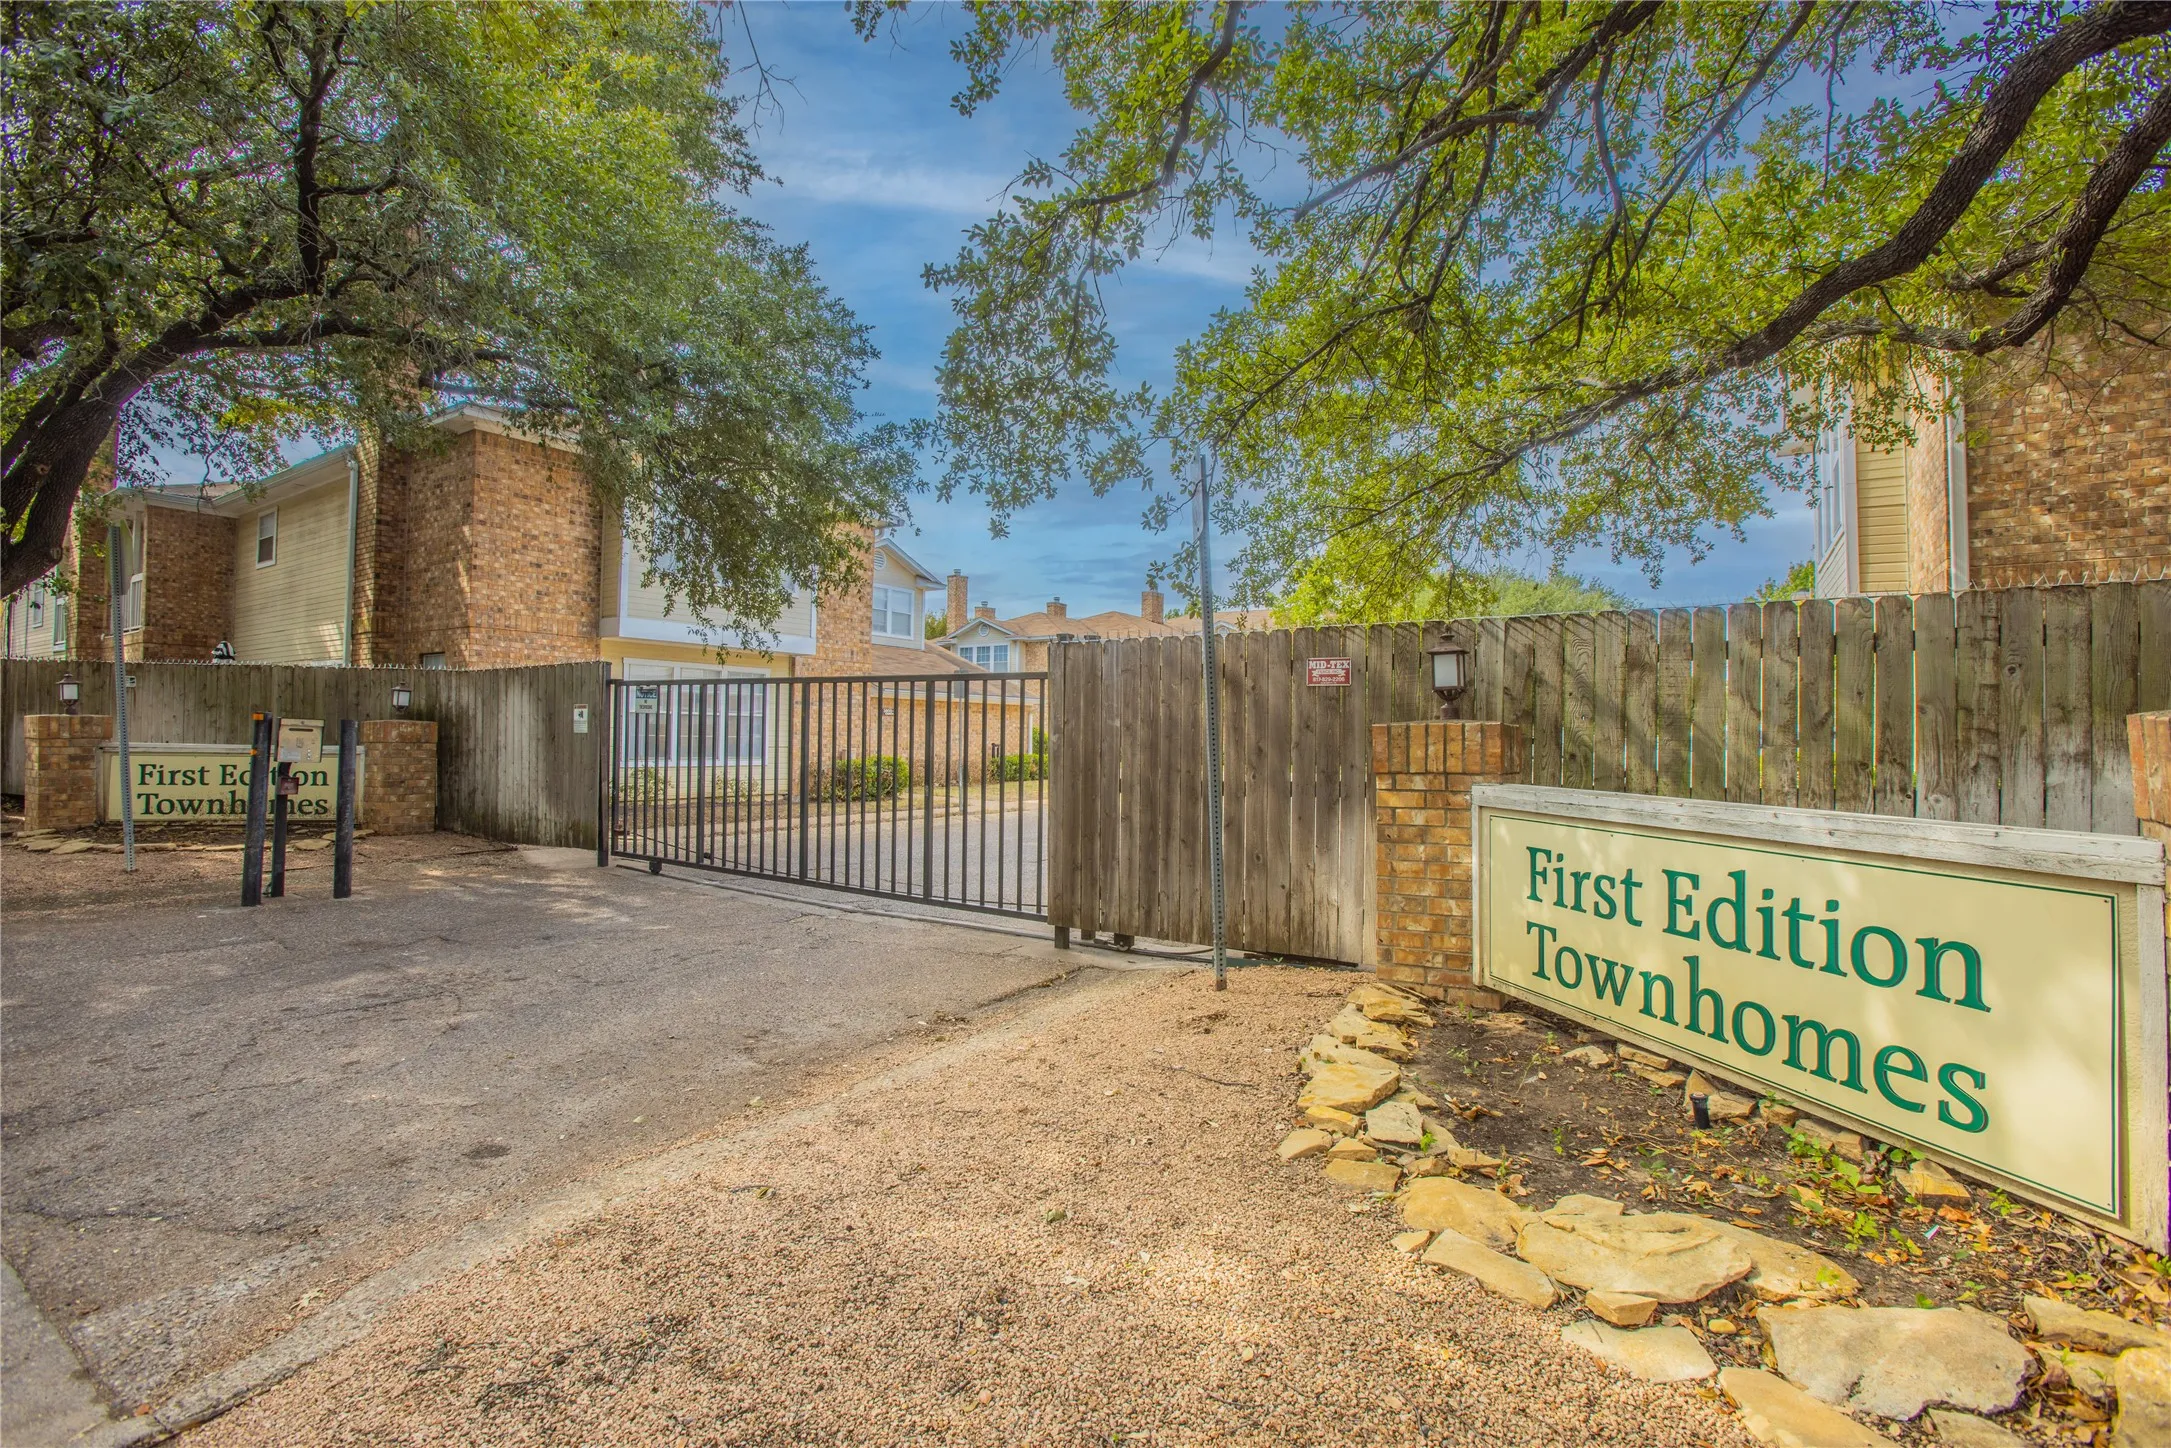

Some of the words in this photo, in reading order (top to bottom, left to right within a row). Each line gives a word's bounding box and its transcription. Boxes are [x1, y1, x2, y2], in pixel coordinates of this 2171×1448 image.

[1309, 660, 1350, 669] MID-TEX
[137, 763, 210, 786] First
[219, 761, 330, 786] Eton
[137, 790, 329, 815] Townhmes
[1526, 846, 1643, 927] First
[1662, 869, 1992, 1013] Edition
[1526, 921, 1990, 1134] Townhomes
